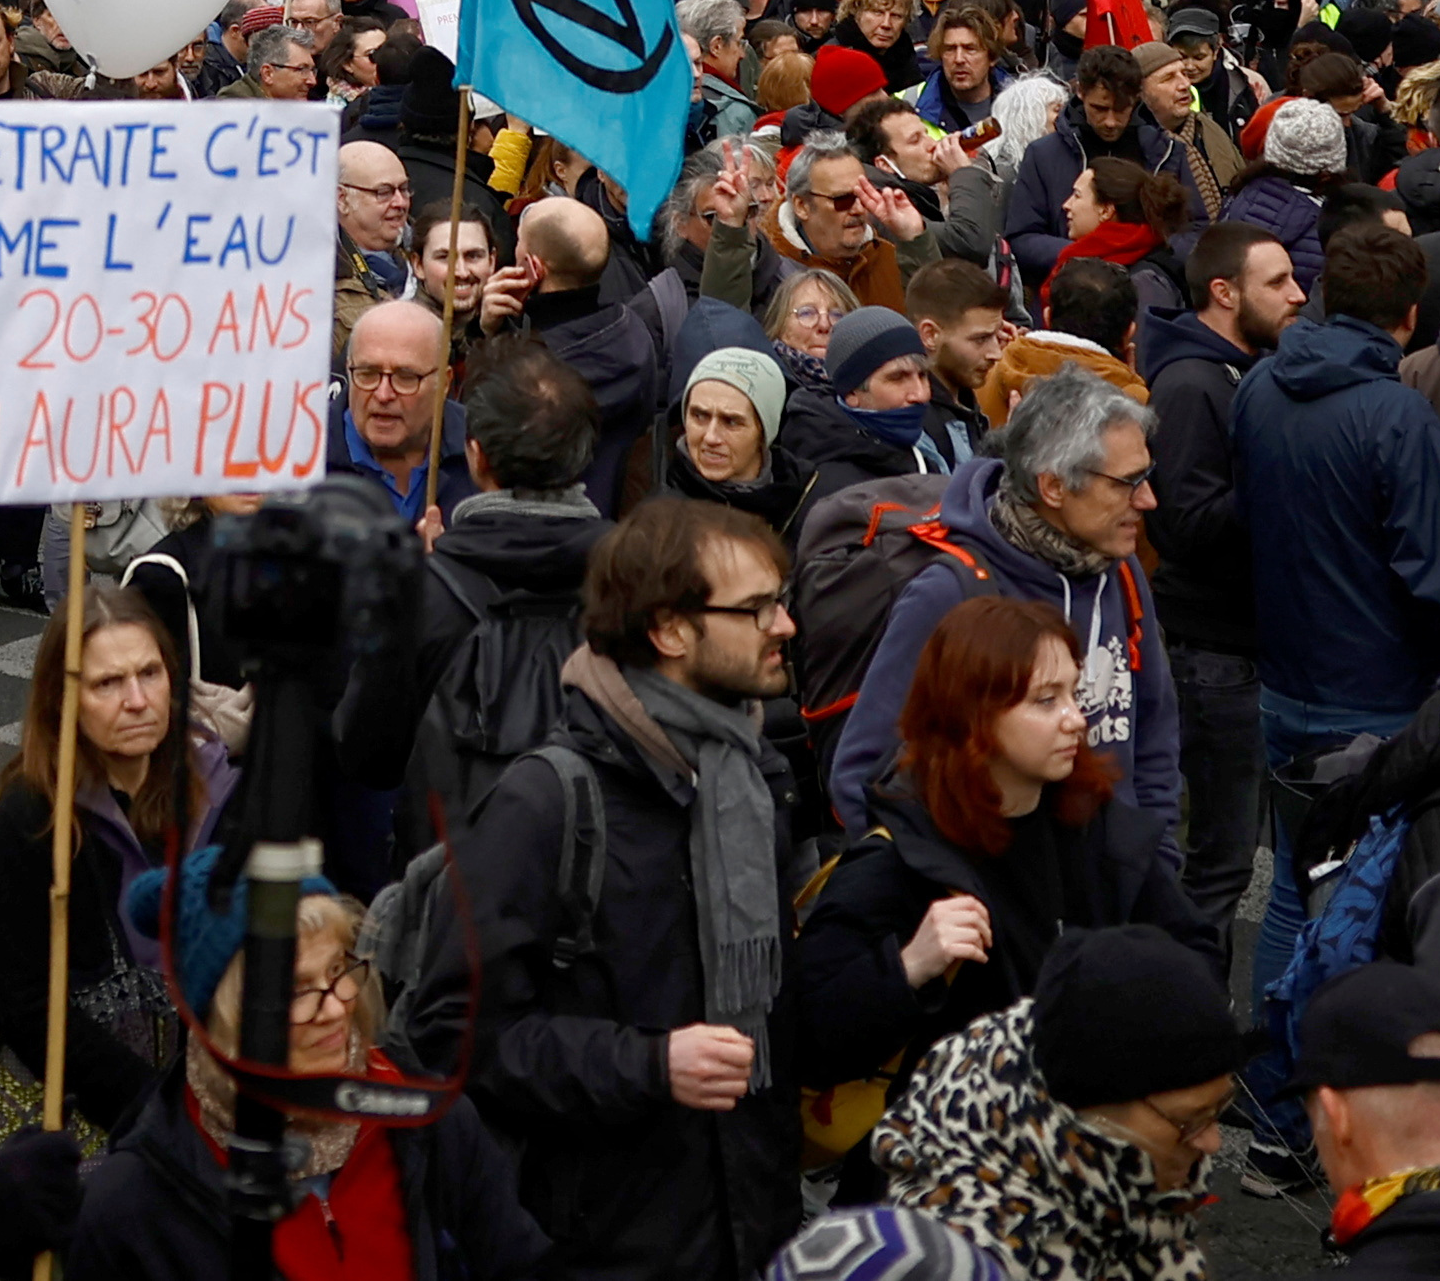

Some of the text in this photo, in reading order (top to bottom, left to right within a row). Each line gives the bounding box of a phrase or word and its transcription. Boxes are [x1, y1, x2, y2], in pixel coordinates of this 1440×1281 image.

[204, 114, 329, 179] C'EST
[104, 202, 296, 272] L'EAU
[17, 289, 192, 369] 20-30
[207, 282, 313, 355] ANS
[17, 384, 172, 488] AURA
[194, 379, 324, 480] PLUS
[1088, 714, 1130, 748] ots
[334, 1083, 430, 1117] Canon
